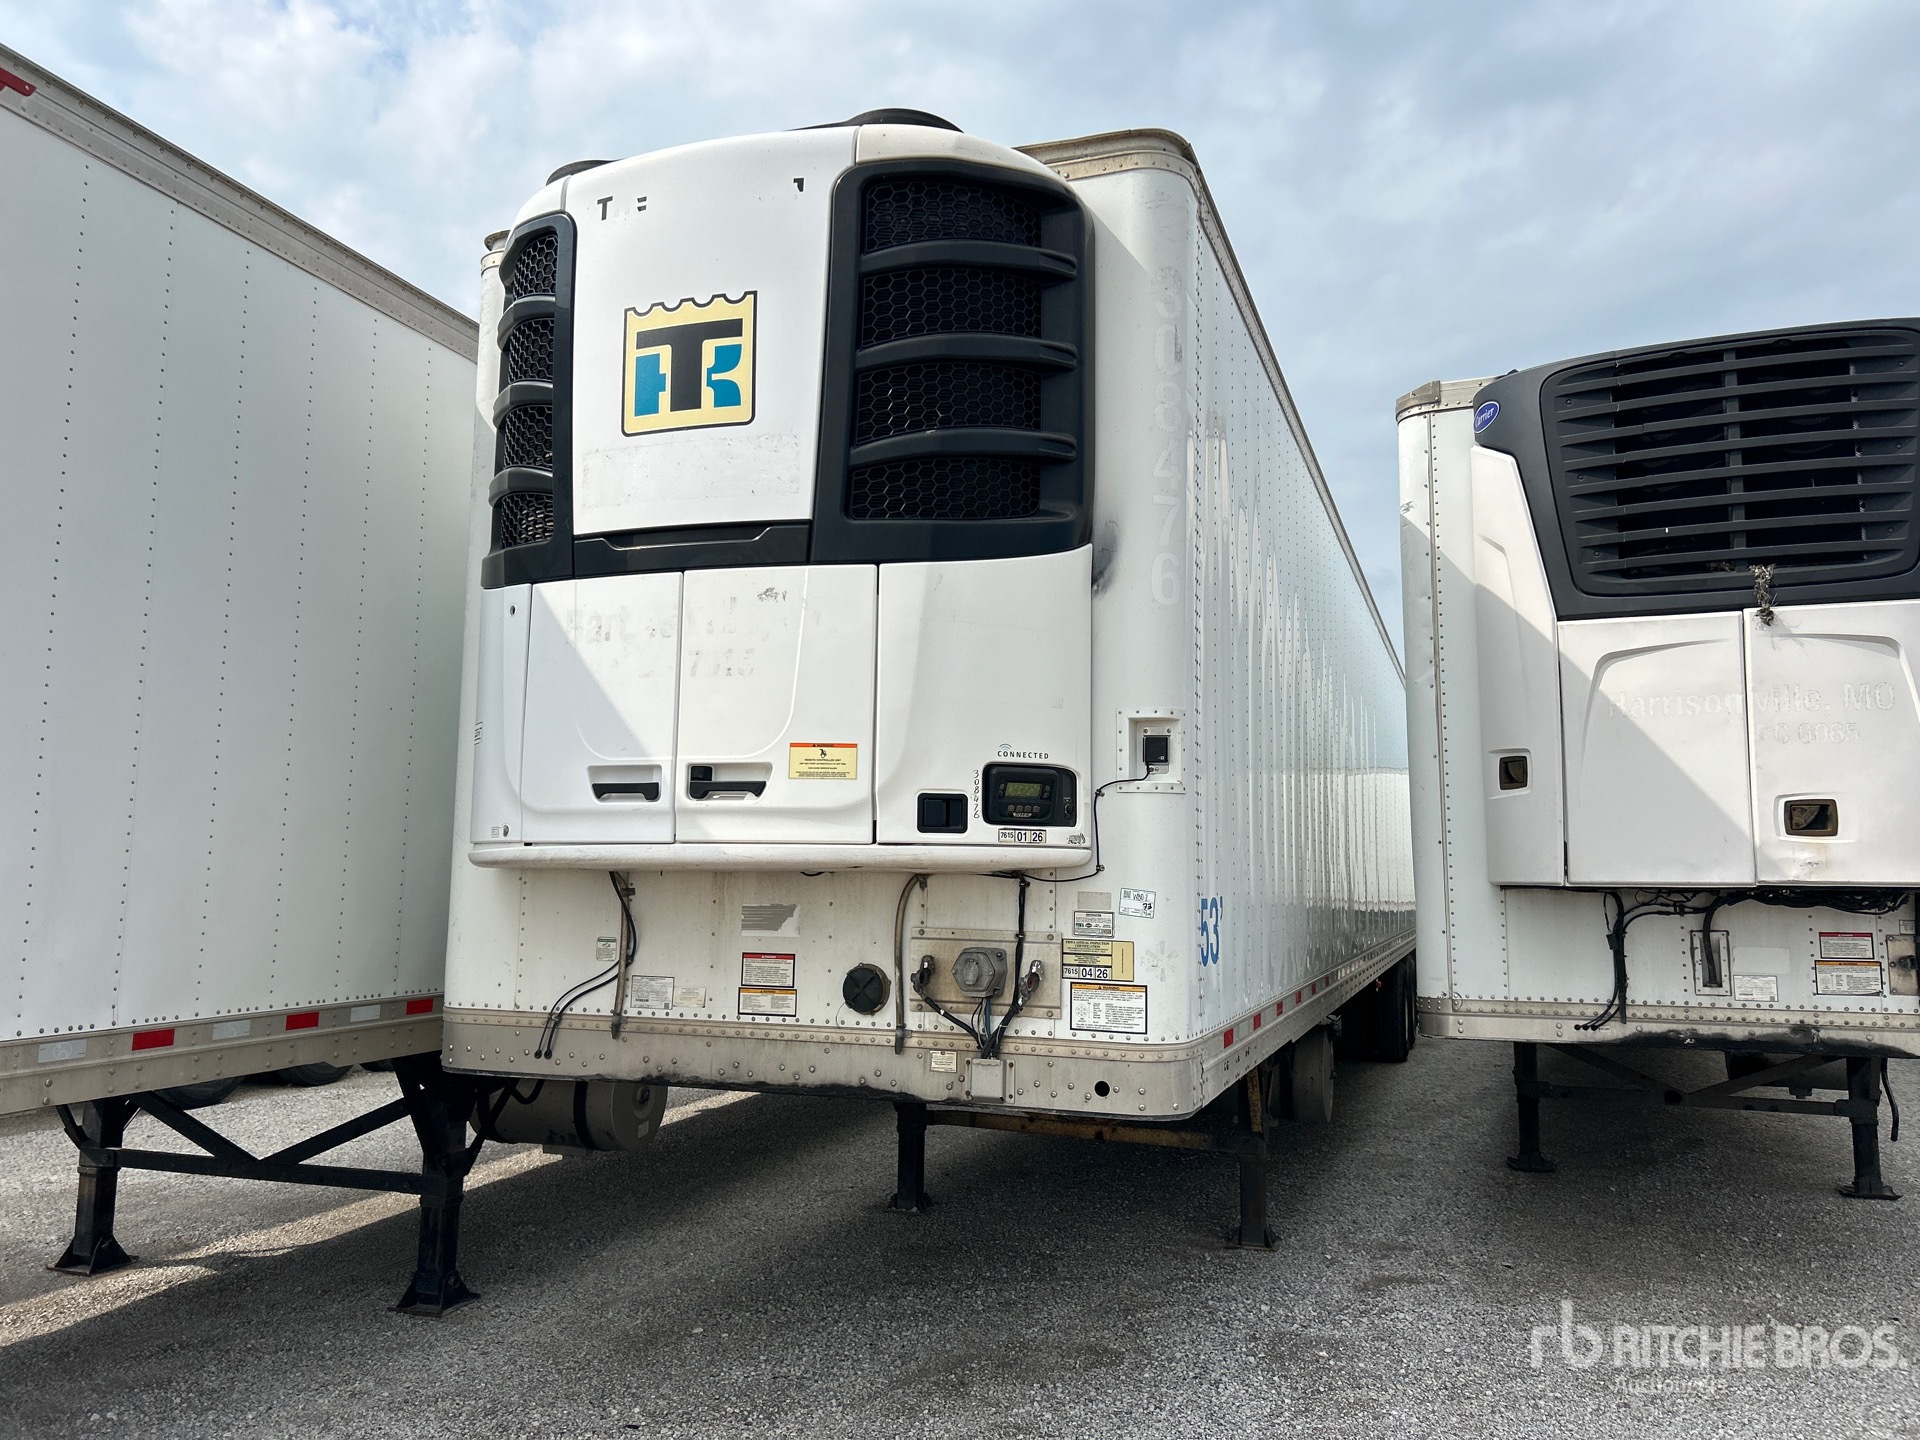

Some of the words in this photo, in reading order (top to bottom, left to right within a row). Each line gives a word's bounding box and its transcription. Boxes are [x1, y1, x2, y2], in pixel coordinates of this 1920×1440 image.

[1475, 407, 1495, 428] Carrier
[1843, 681, 1896, 711] MO
[1798, 722, 1860, 744] 6065
[997, 750, 1049, 760] CONNECTED
[1000, 831, 1014, 839] 7615
[1017, 831, 1028, 842] 01
[1032, 832, 1043, 842] 26
[1200, 896, 1224, 967] 53'
[1081, 967, 1093, 978] 04
[1096, 968, 1108, 979] 26
